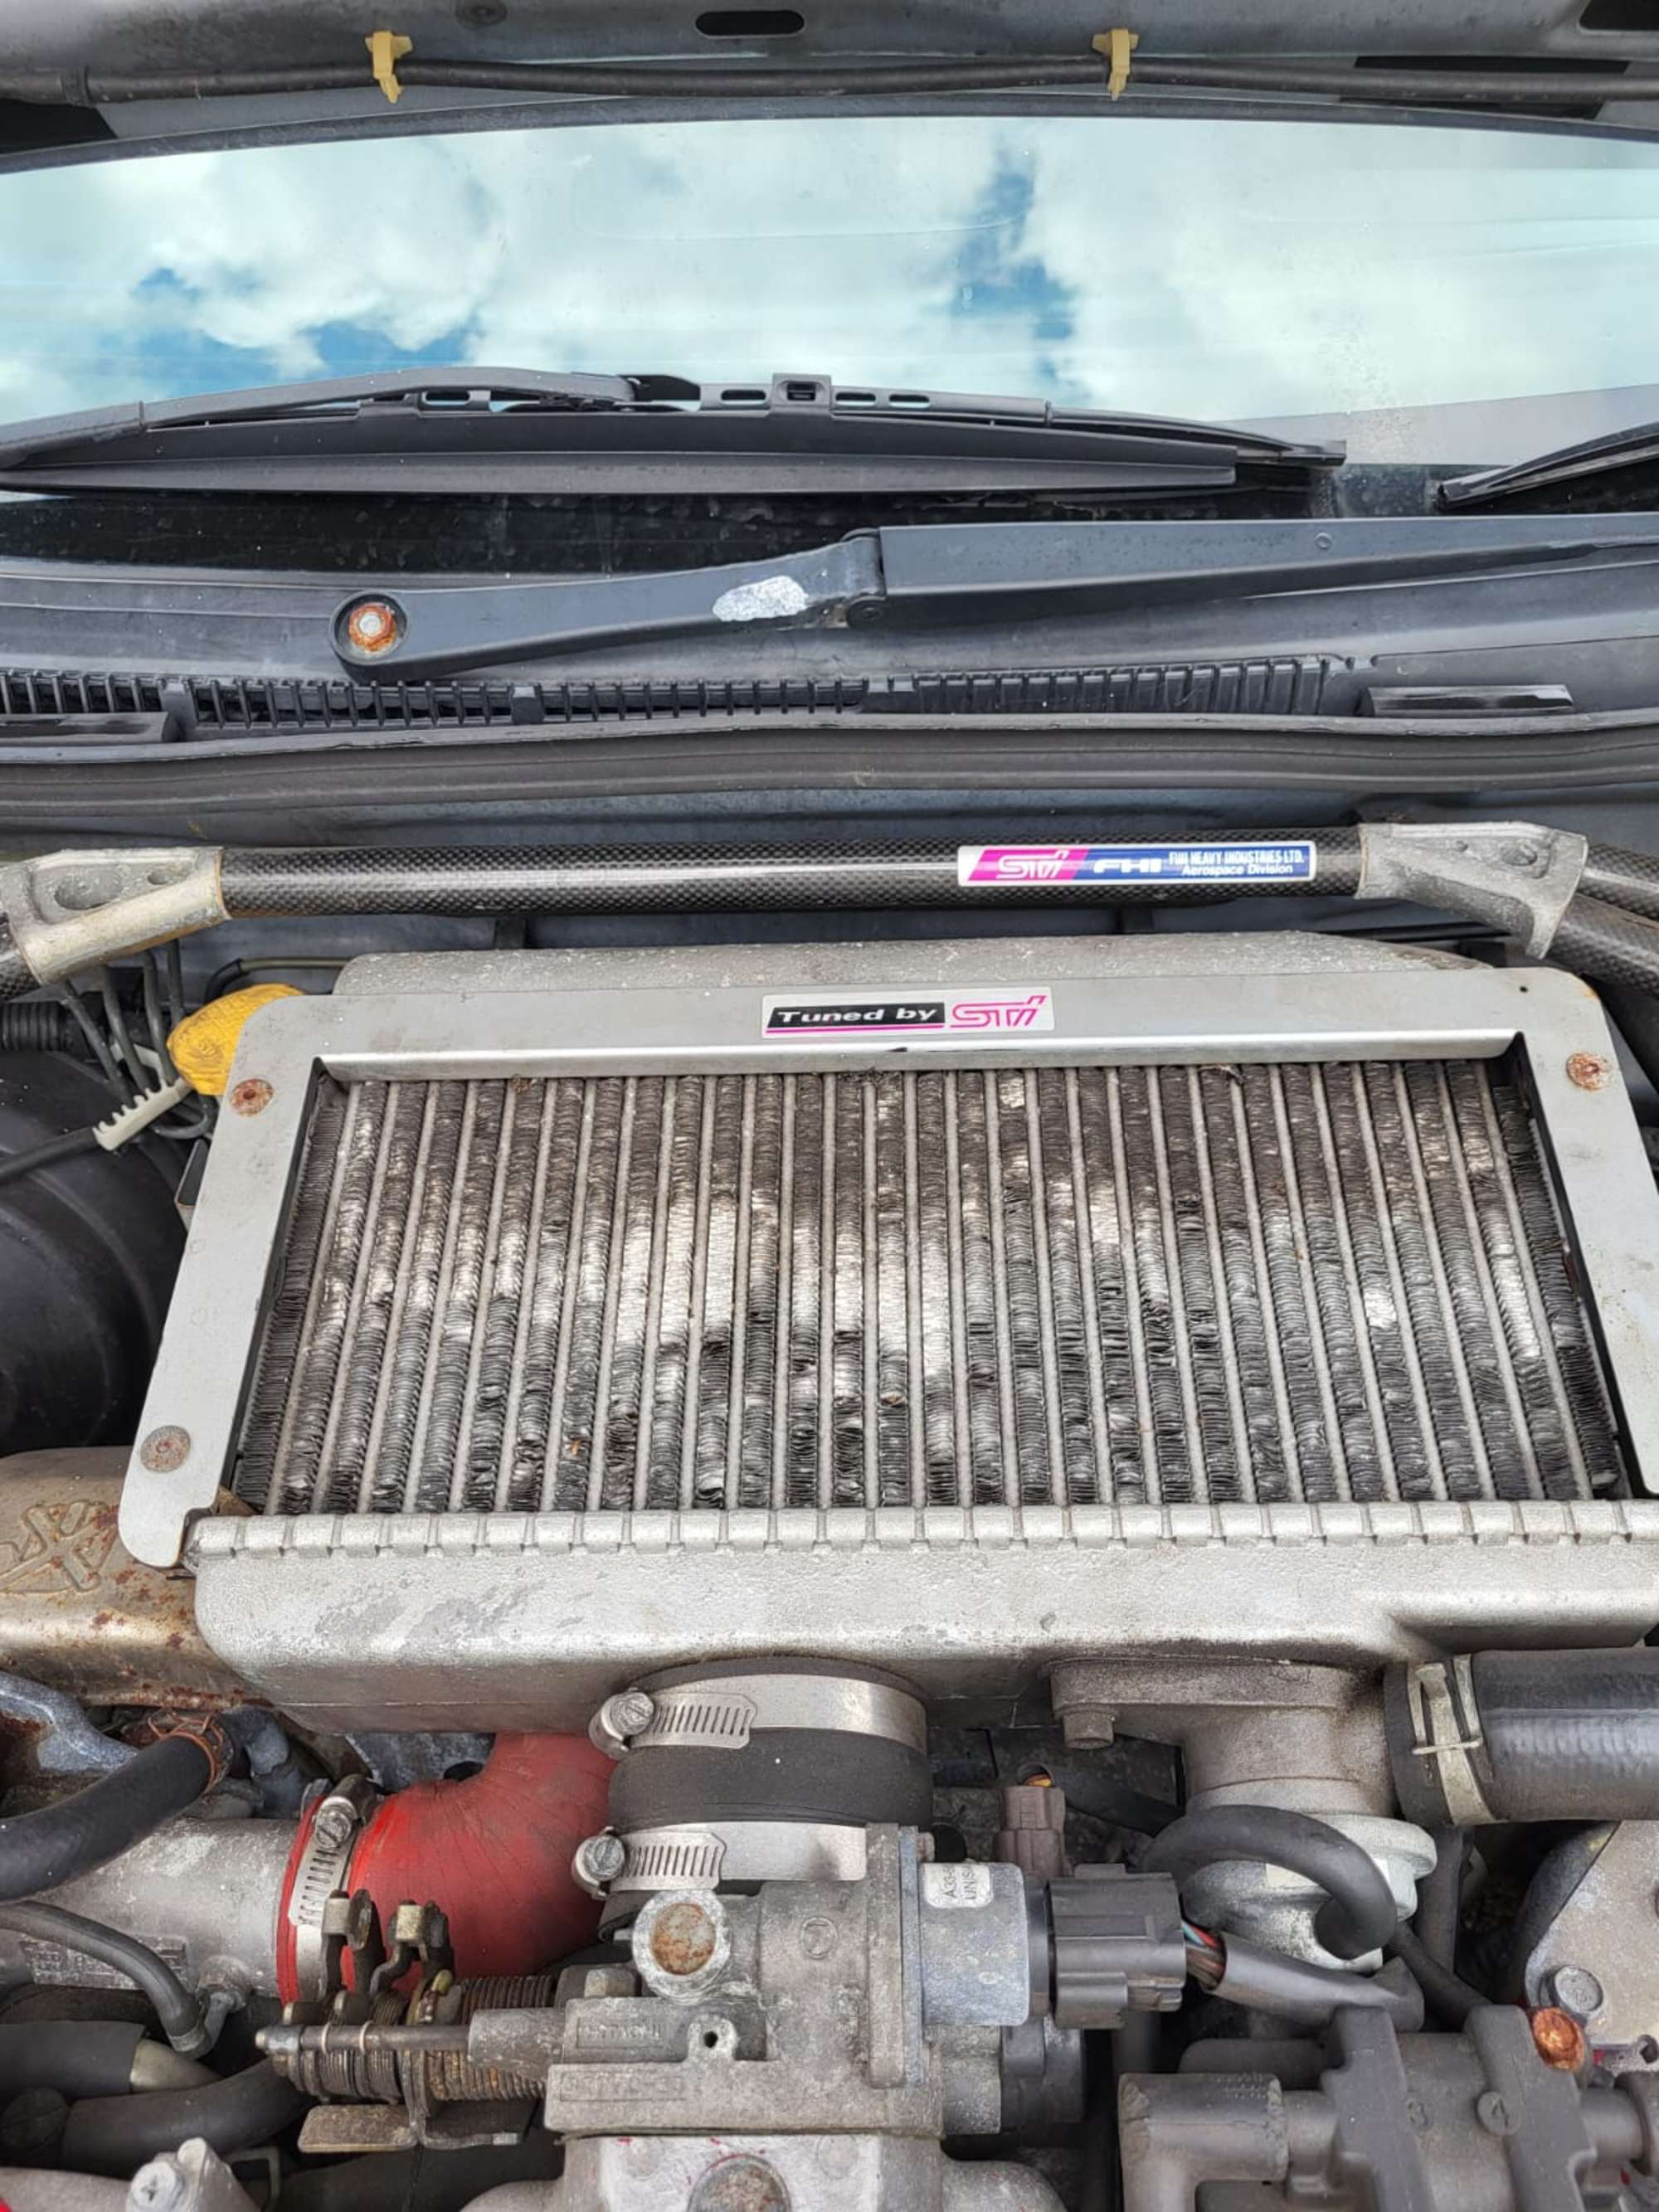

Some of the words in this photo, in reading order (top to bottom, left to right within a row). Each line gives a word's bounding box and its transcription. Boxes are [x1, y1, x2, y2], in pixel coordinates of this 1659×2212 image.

[1191, 851, 1222, 864] HEAVY
[1224, 850, 1282, 864] INDUSTRIES
[1283, 850, 1305, 863] LTD.
[1092, 858, 1162, 873] FHI
[1181, 864, 1244, 878] Aerospace
[1248, 864, 1293, 875] Division
[777, 1009, 884, 1023] Tuned
[895, 1008, 937, 1023] by
